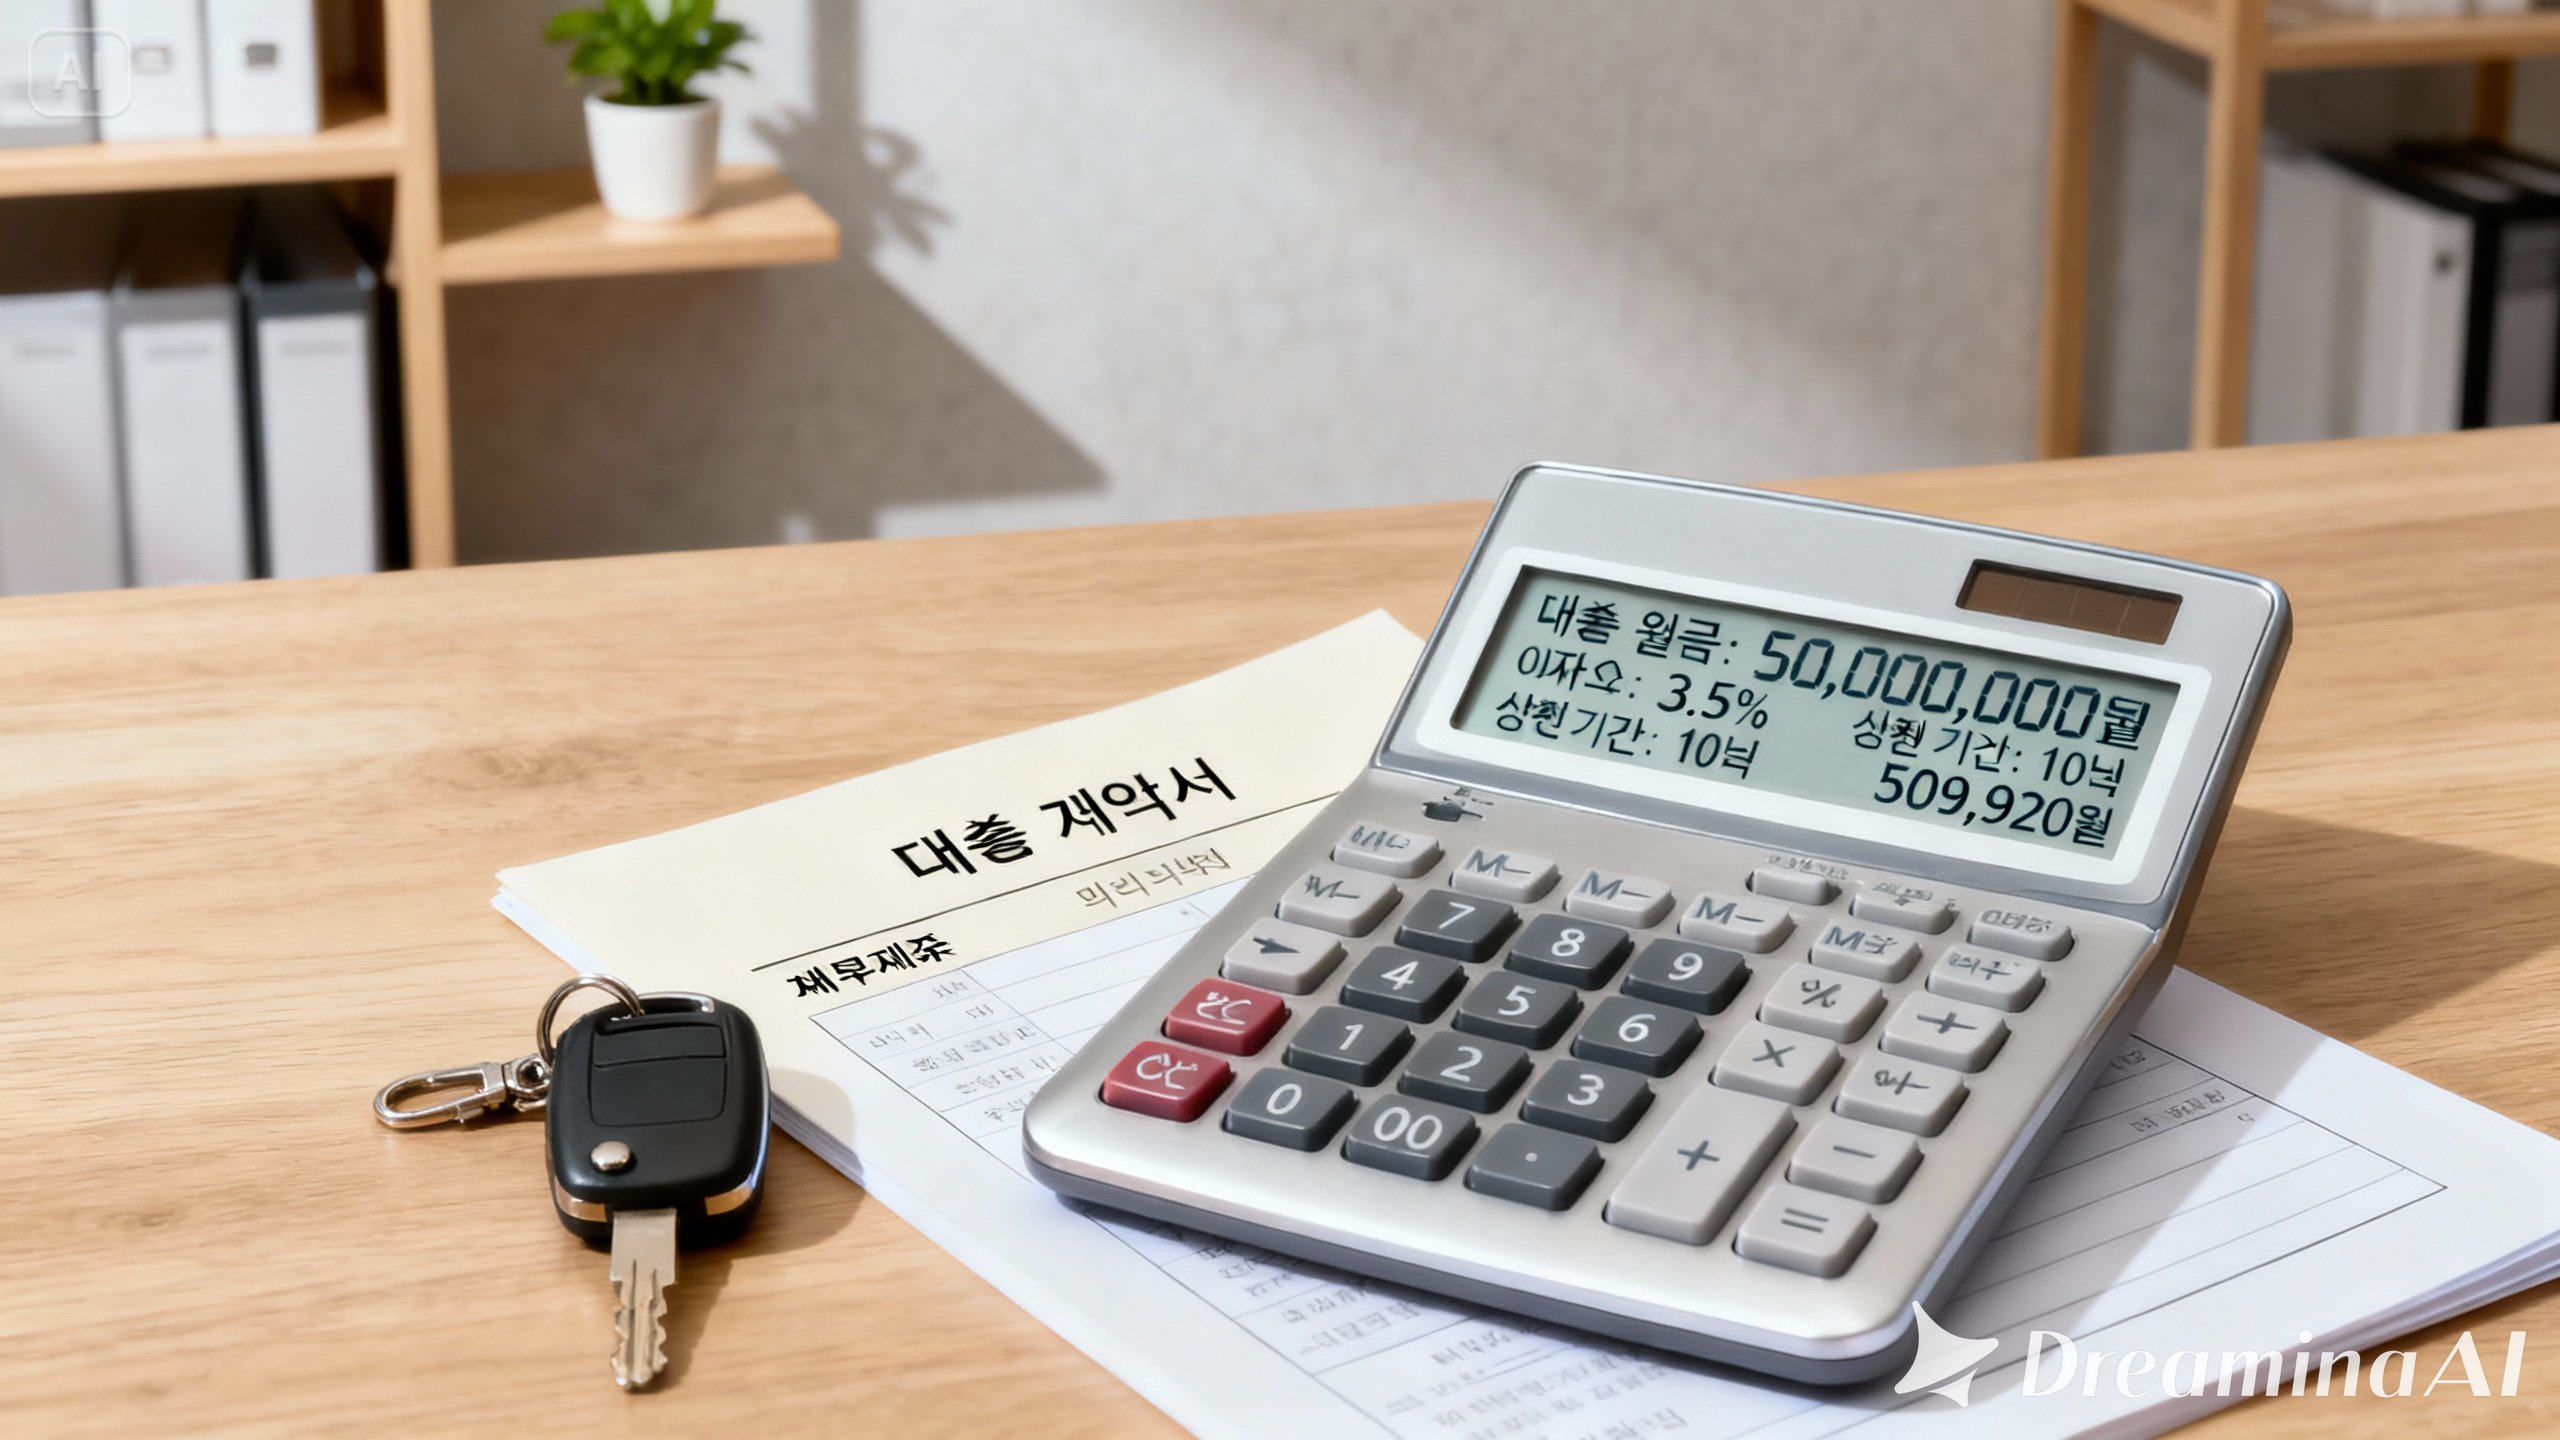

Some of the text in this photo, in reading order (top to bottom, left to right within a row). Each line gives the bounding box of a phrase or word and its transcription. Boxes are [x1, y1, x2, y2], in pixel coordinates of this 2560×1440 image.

[1656, 673, 1769, 730] 3.5%
[1434, 901, 1477, 931] 7
[1550, 927, 1587, 958] 8
[1380, 961, 1419, 991] 4
[1667, 951, 1704, 982] 9
[1497, 984, 1537, 1017] 5
[1342, 1022, 1366, 1052] 1
[1617, 1013, 1657, 1043] 6
[1440, 1045, 1484, 1083] 2
[1265, 1082, 1303, 1115] 0
[1566, 1073, 1605, 1106] 3
[1372, 1105, 1444, 1151] 00
